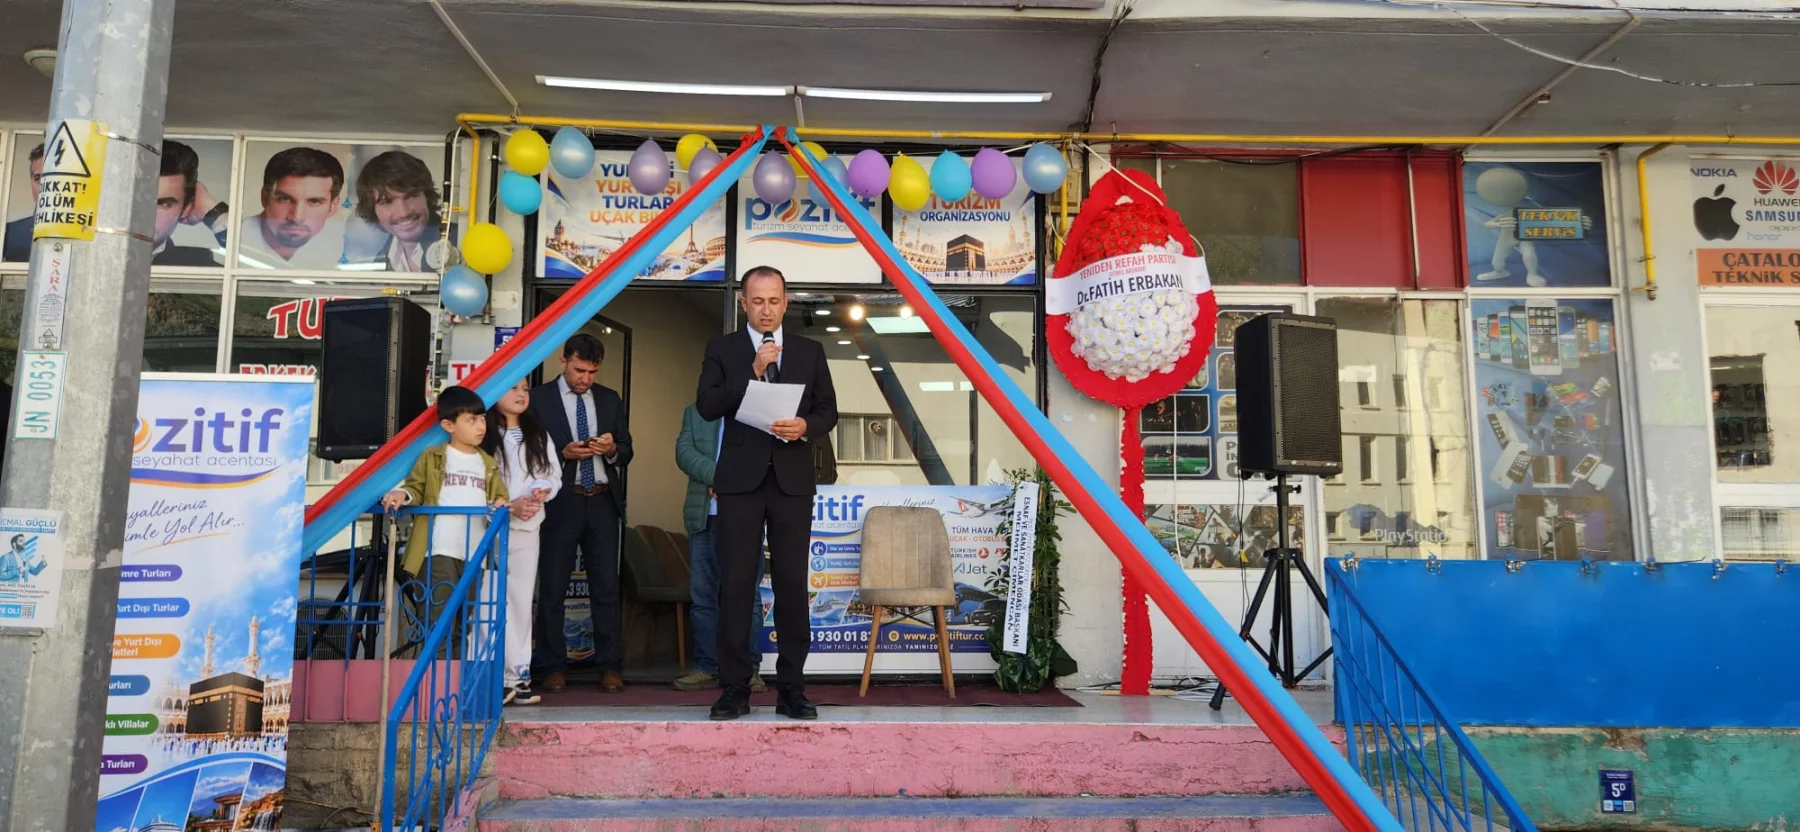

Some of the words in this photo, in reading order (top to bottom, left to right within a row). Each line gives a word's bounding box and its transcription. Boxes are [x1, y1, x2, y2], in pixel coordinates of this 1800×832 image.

[1690, 168, 1737, 177] NOKIA
[595, 179, 632, 194] YUR
[590, 210, 635, 226] UÇAK
[920, 210, 1010, 222] ORGANİZASYONU
[1745, 210, 1800, 222] SAMSU
[1128, 273, 1184, 292] ERBAKAN
[27, 360, 57, 400] 0053
[132, 454, 200, 468] seyahat
[207, 454, 277, 466] acentası
[444, 472, 468, 486] NEW
[952, 525, 969, 534] TÜM
[121, 570, 140, 578] mre
[141, 569, 172, 577] Turları
[152, 604, 180, 612] Turlar
[124, 638, 142, 646] Yurt
[817, 631, 841, 642] 930
[843, 631, 857, 641] 01
[118, 719, 150, 728] Villalar
[107, 759, 136, 769] Turları
